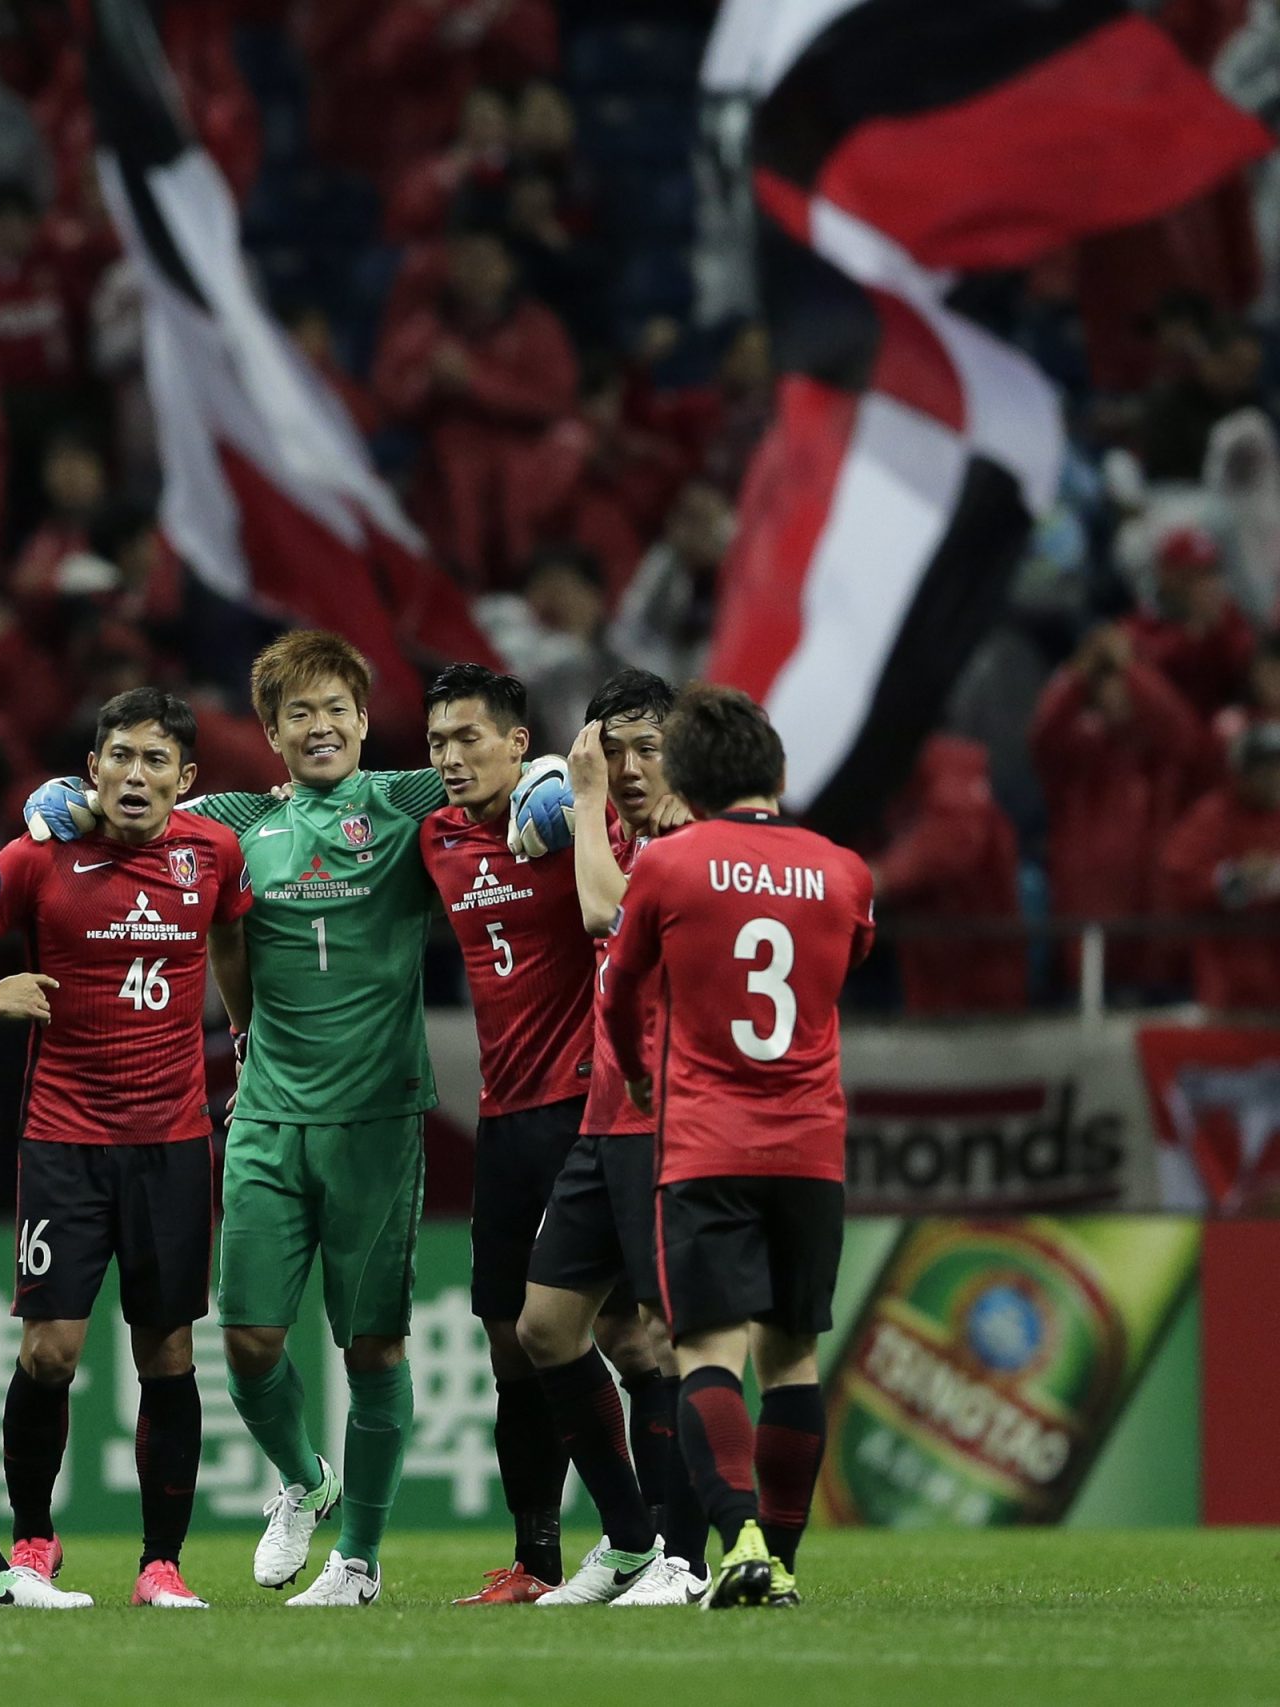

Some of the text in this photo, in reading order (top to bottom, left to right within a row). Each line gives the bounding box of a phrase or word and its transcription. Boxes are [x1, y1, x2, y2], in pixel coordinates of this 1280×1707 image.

[264, 886, 371, 900] HEAVY INDUSTRIES
[284, 881, 349, 892] MITSUBISHI
[463, 884, 513, 901] MITSUBISHI
[709, 859, 825, 901] UGAJIN
[451, 888, 534, 912] HEAVY INDUSTRIES
[86, 930, 198, 941] HEAVY INDUSTRIES
[110, 922, 179, 933] MITSUBISHI
[311, 916, 328, 972] 1
[485, 921, 514, 977] 5
[118, 956, 171, 1011] 46
[730, 917, 797, 1062] 3
[18, 1218, 52, 1276] 46
